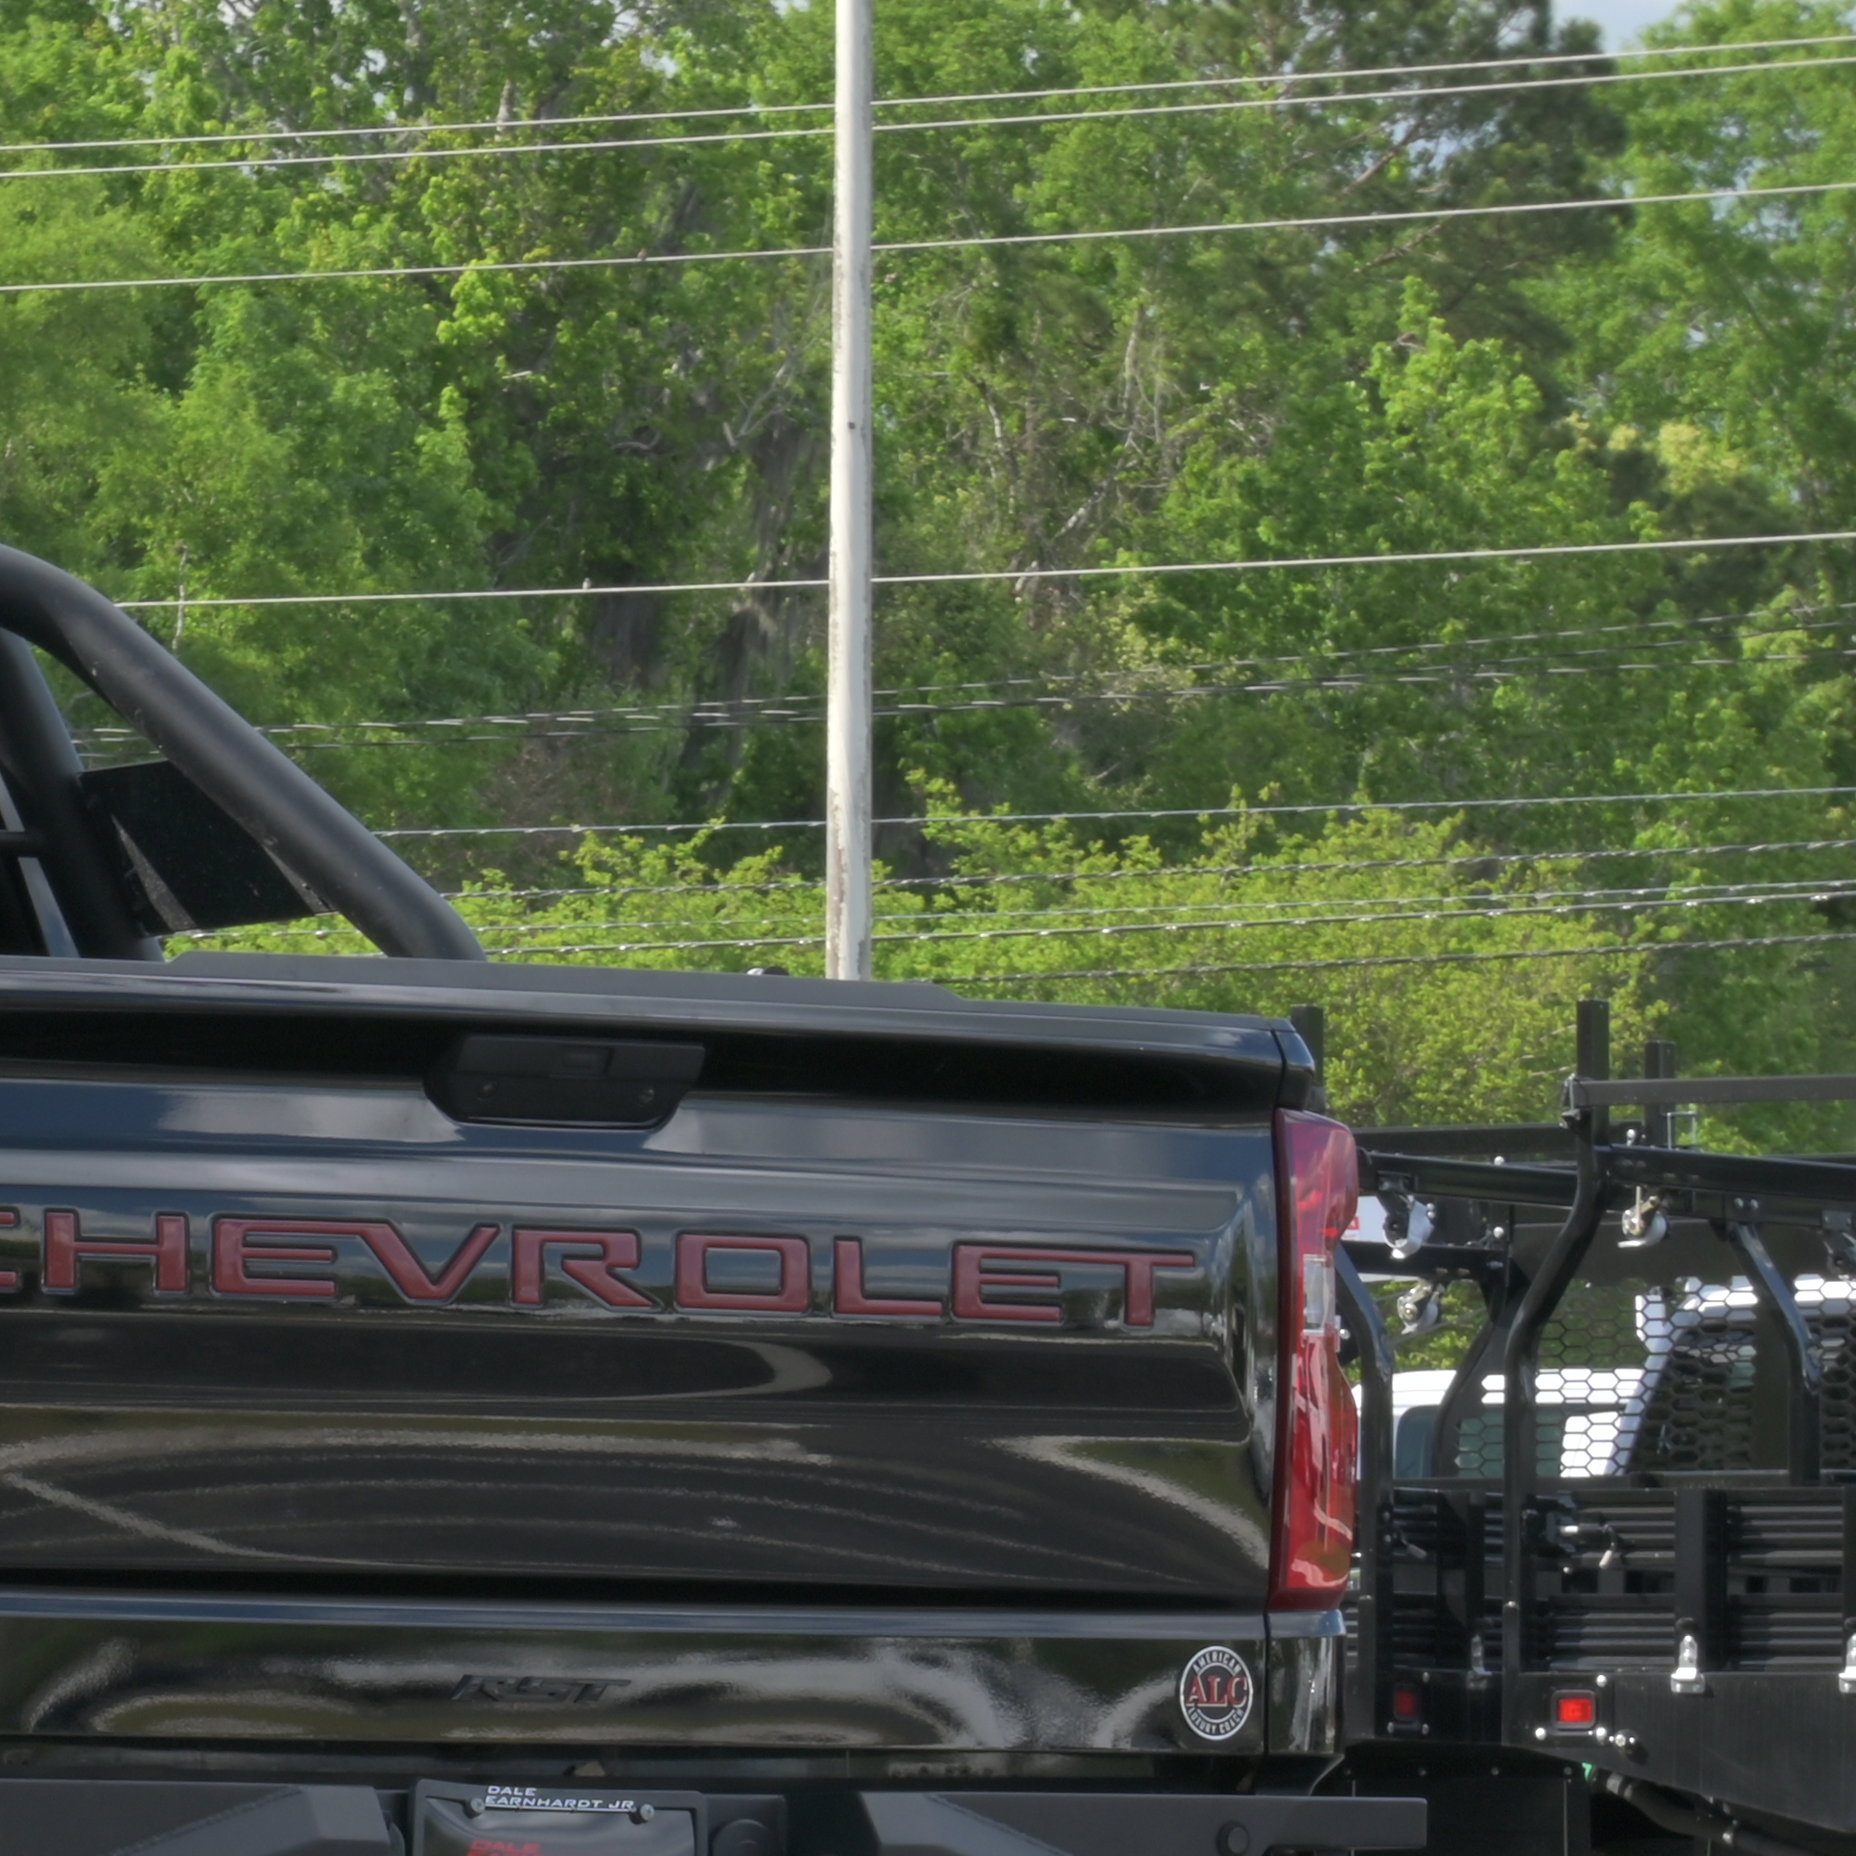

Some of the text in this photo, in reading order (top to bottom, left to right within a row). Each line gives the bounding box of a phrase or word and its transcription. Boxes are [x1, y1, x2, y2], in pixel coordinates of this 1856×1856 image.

[1192, 1651, 1242, 1675] AMERICAN
[1186, 1674, 1249, 1709] ALC
[1218, 1707, 1245, 1735] COACH
[487, 1785, 537, 1796] DALE
[485, 1795, 636, 1811] EARNHARDT JR
